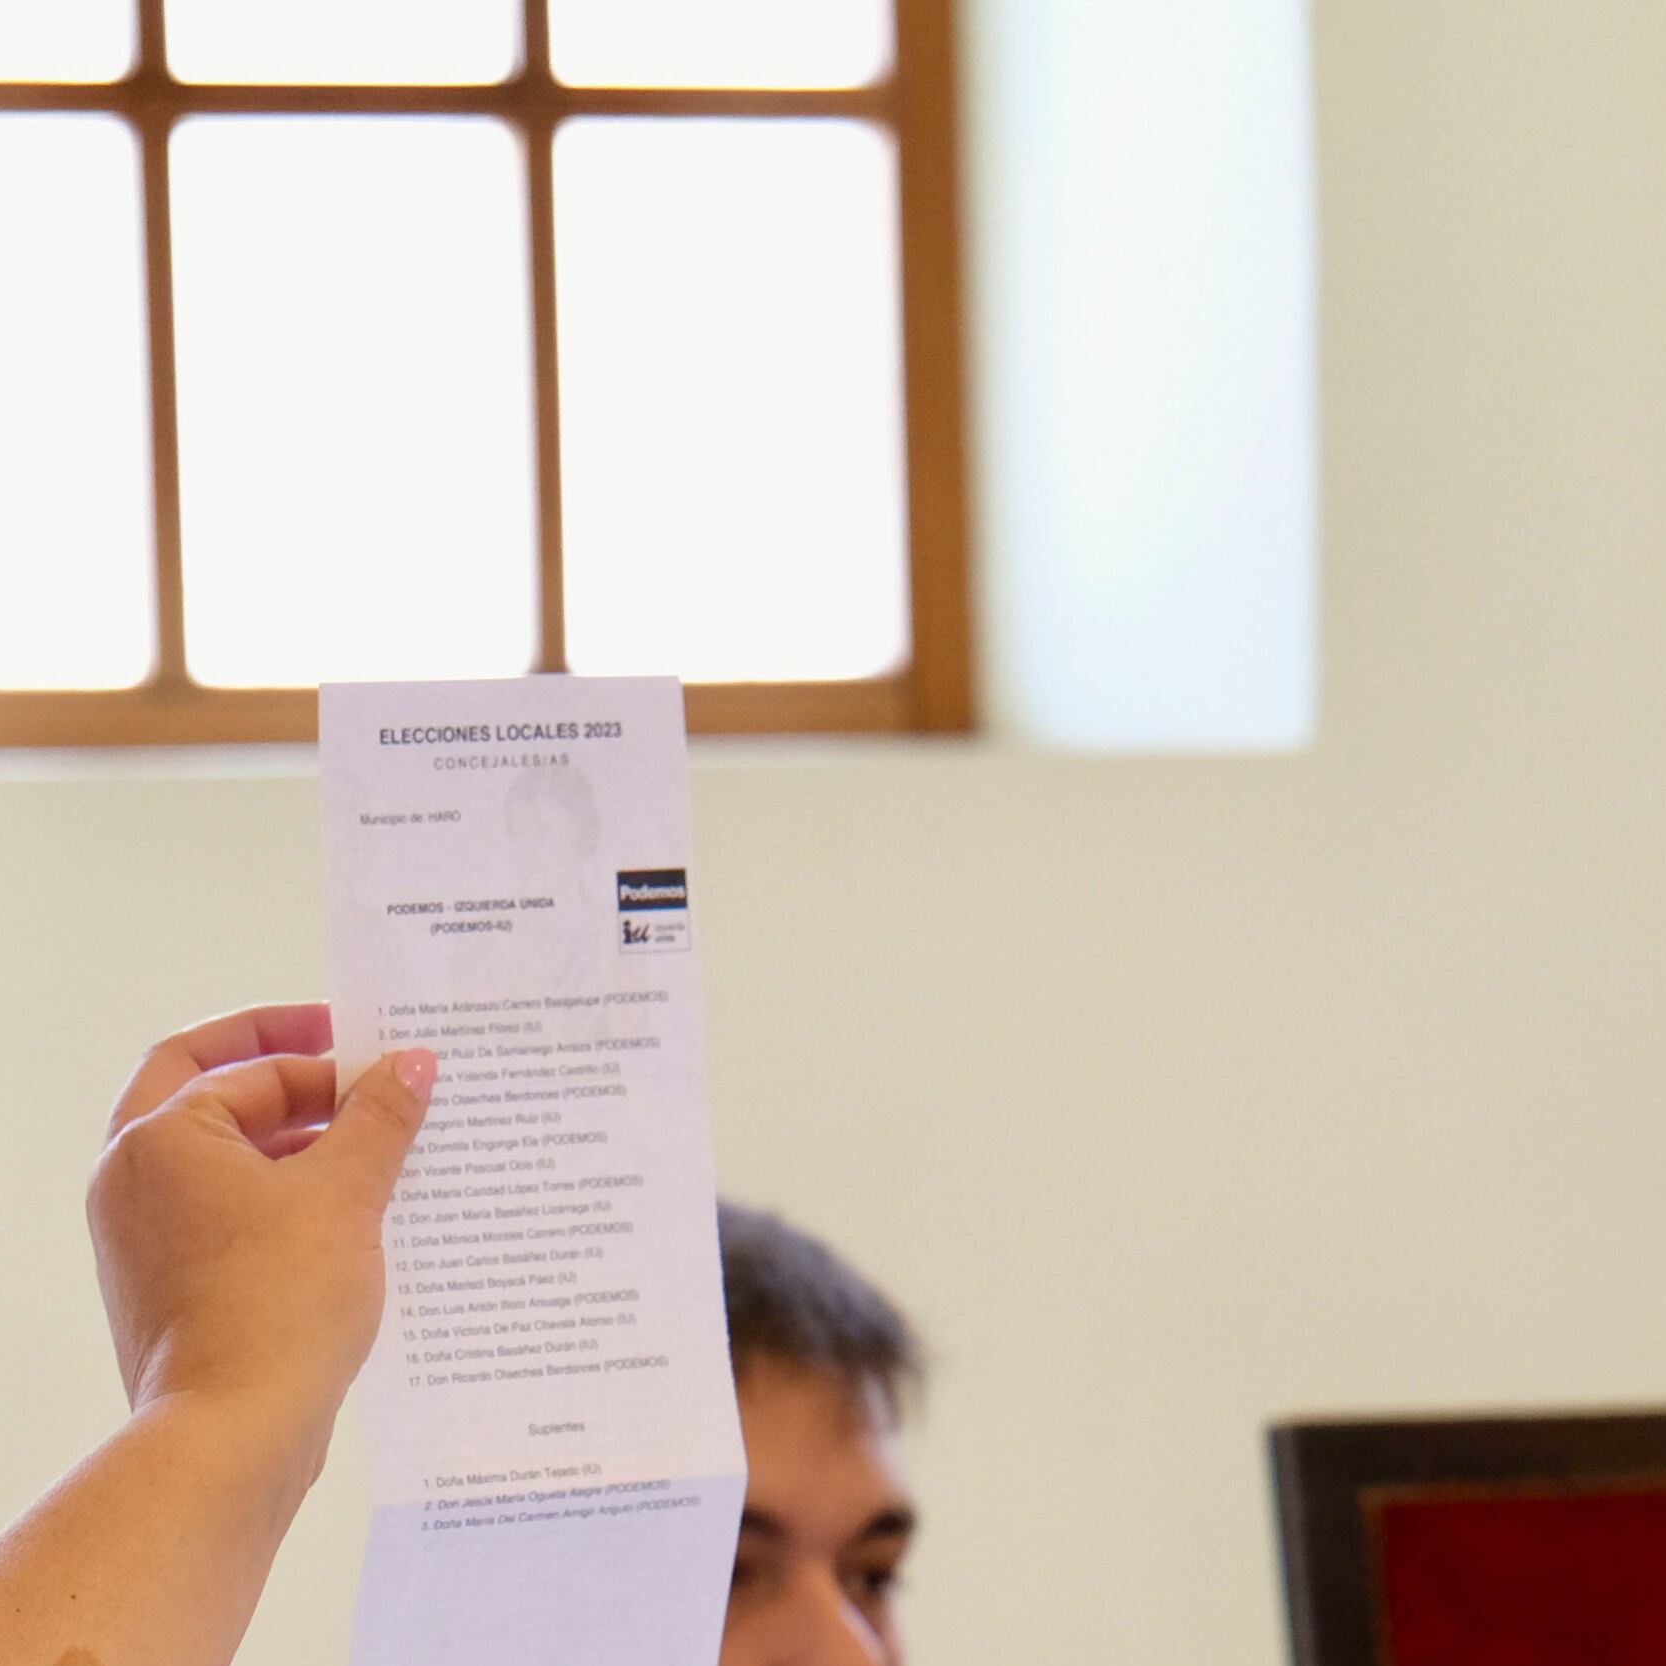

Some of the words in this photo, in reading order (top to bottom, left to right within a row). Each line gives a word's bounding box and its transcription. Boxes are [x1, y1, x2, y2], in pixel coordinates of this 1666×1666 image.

[379, 725, 491, 746] ELECCIONES
[496, 723, 579, 742] LOCALES
[584, 722, 623, 739] 2023
[434, 753, 570, 771] CONCEJALES/AS
[359, 813, 408, 826] Municipio
[410, 813, 423, 824] de
[387, 901, 444, 916] PODEMOS
[454, 899, 516, 914] IZQUIERDA
[519, 898, 555, 911] UNIDA
[389, 1004, 417, 1016] Doña
[390, 1028, 411, 1039] Don
[478, 1046, 493, 1057] De
[401, 1189, 429, 1201] Doña
[410, 1213, 431, 1224] Don
[434, 1211, 459, 1222] Juan
[412, 1235, 440, 1247] Doña
[414, 1259, 435, 1270] Don
[438, 1257, 463, 1269] Juan
[416, 1281, 444, 1293] Doña
[419, 1305, 441, 1316] Don
[421, 1327, 450, 1339] Doña
[494, 1322, 509, 1334] De
[424, 1350, 452, 1362] Doña
[427, 1374, 449, 1385] Don
[436, 1475, 464, 1487] Doña
[438, 1499, 460, 1509] Don
[434, 1519, 462, 1530] Doña
